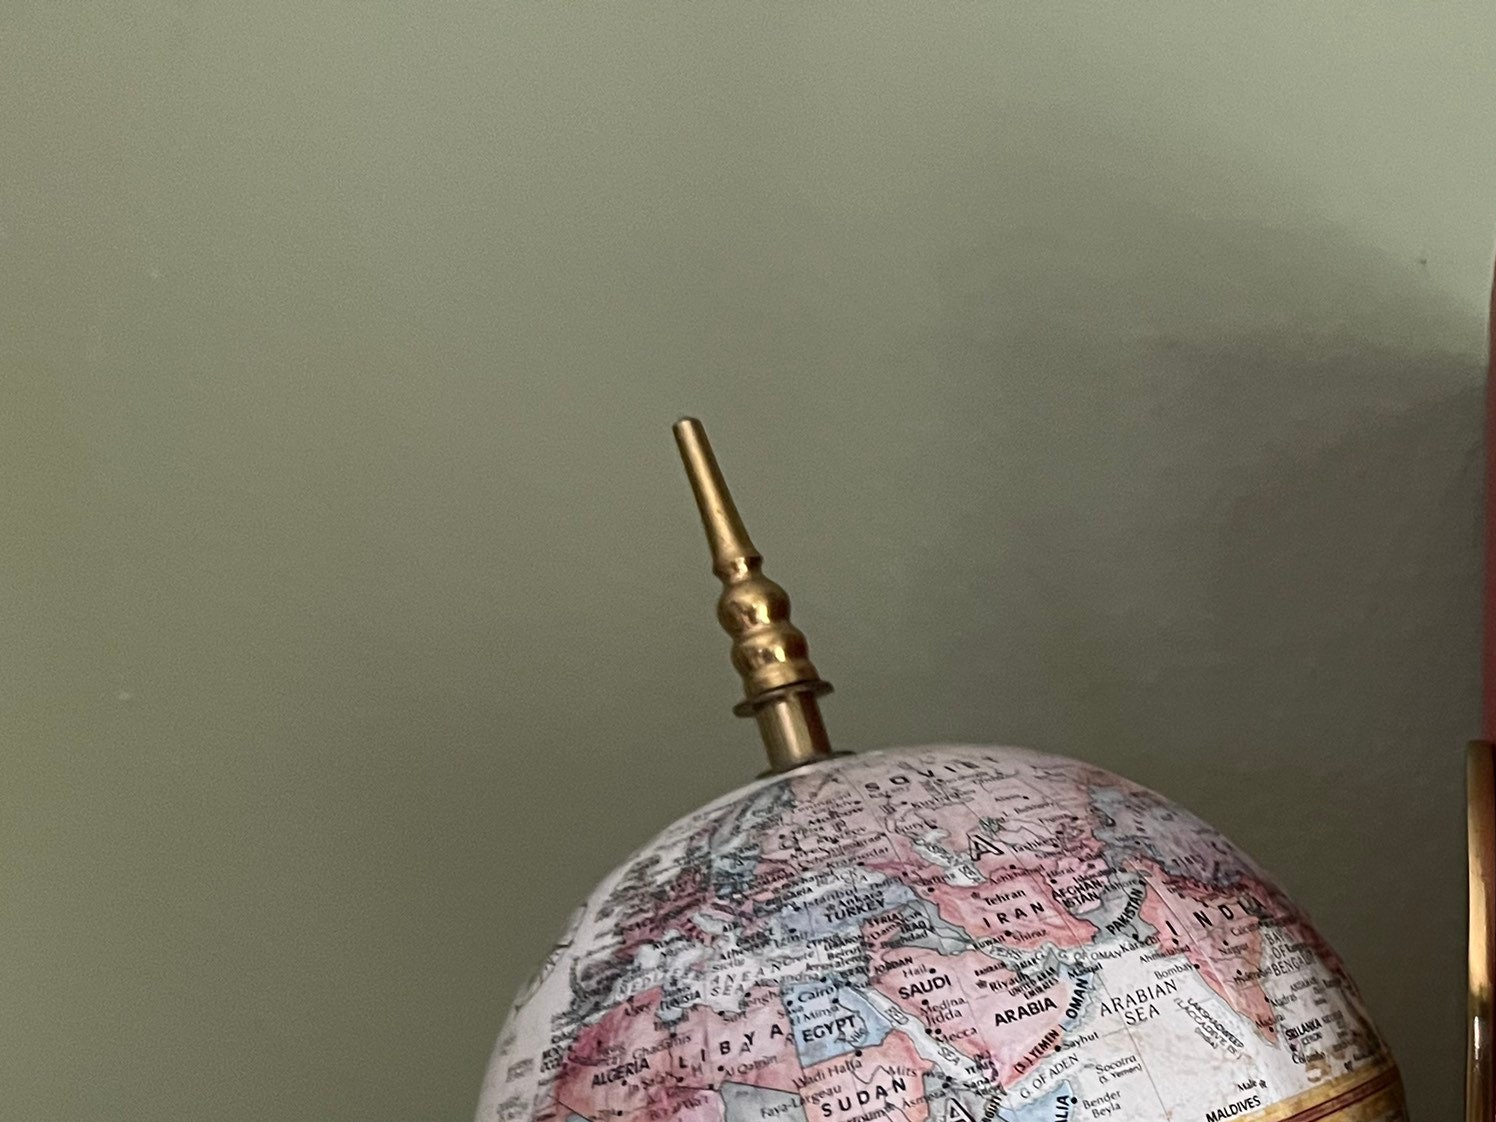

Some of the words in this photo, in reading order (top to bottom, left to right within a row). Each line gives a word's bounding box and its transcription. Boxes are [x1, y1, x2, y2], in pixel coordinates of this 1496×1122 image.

[823, 899, 885, 923] TURKEY
[983, 902, 1045, 928] IRAN
[1106, 887, 1144, 935] PAKISTAN
[899, 974, 952, 1000] SAUDI
[994, 997, 1057, 1027] ARABIA
[1065, 977, 1090, 1021] OMAN
[1100, 978, 1179, 1018] ARABIAN
[1125, 1004, 1162, 1027] SEA
[802, 1015, 857, 1043] EGYPT
[591, 1057, 650, 1089] ALGERIA
[821, 1077, 907, 1117] SUDAN
